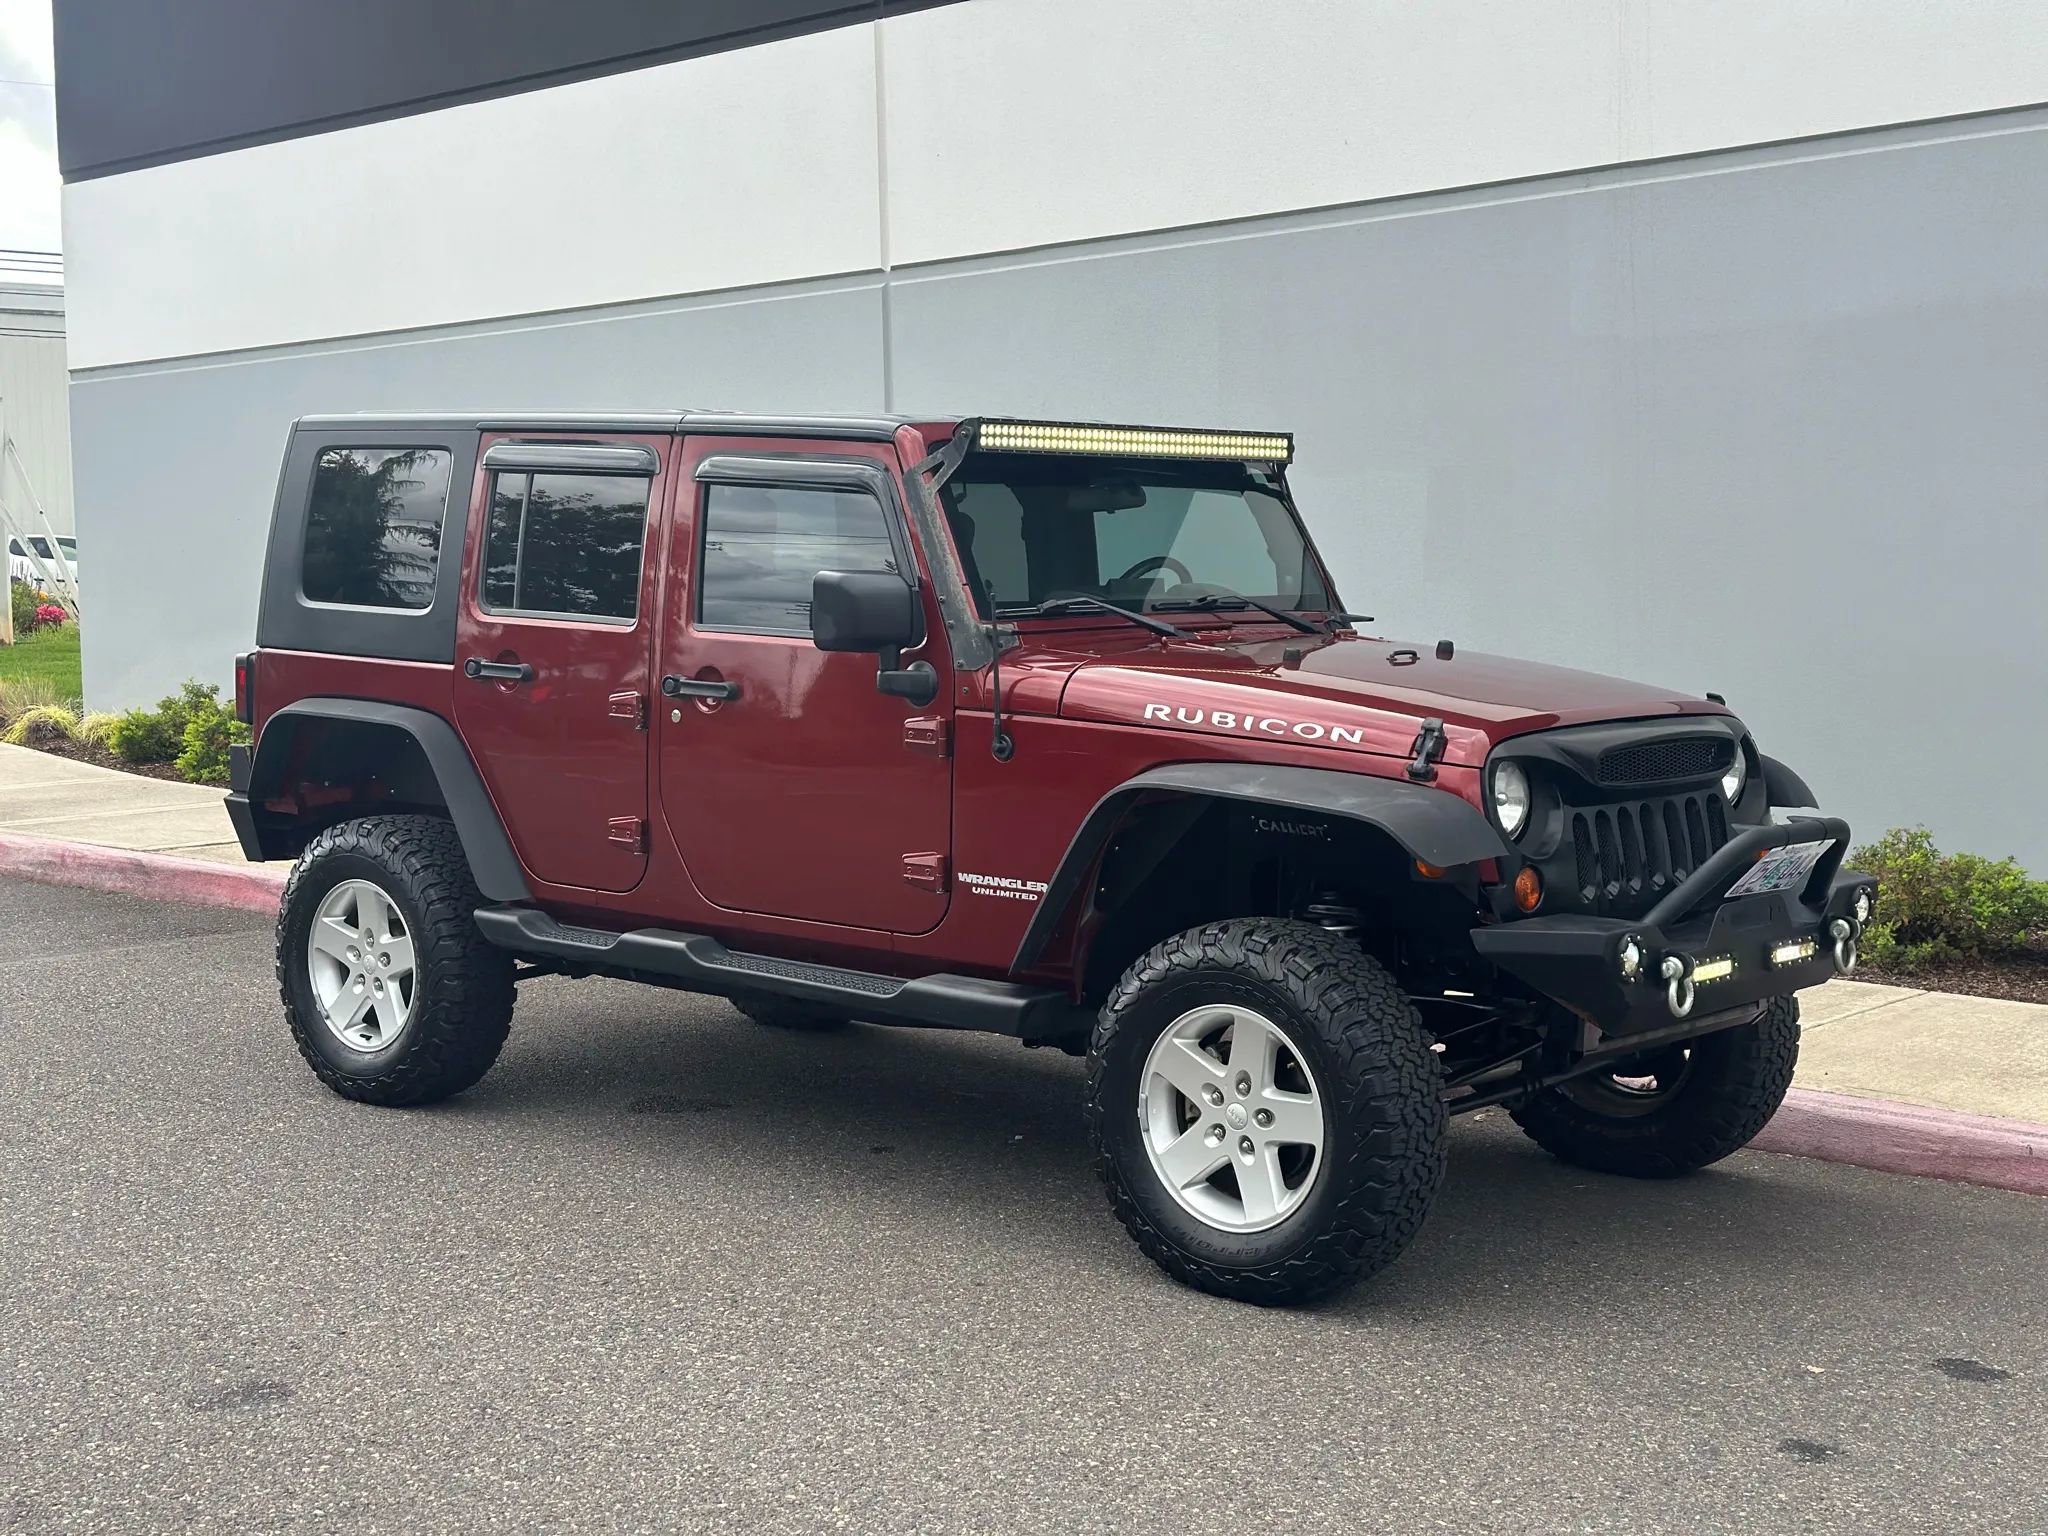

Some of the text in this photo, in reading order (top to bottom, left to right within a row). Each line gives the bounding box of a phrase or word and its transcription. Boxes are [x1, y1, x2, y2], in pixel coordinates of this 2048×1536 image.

[1143, 703, 1364, 744] RUBICON
[958, 872, 1048, 892] WRANGLER
[972, 886, 1038, 901] UNLIMITED
